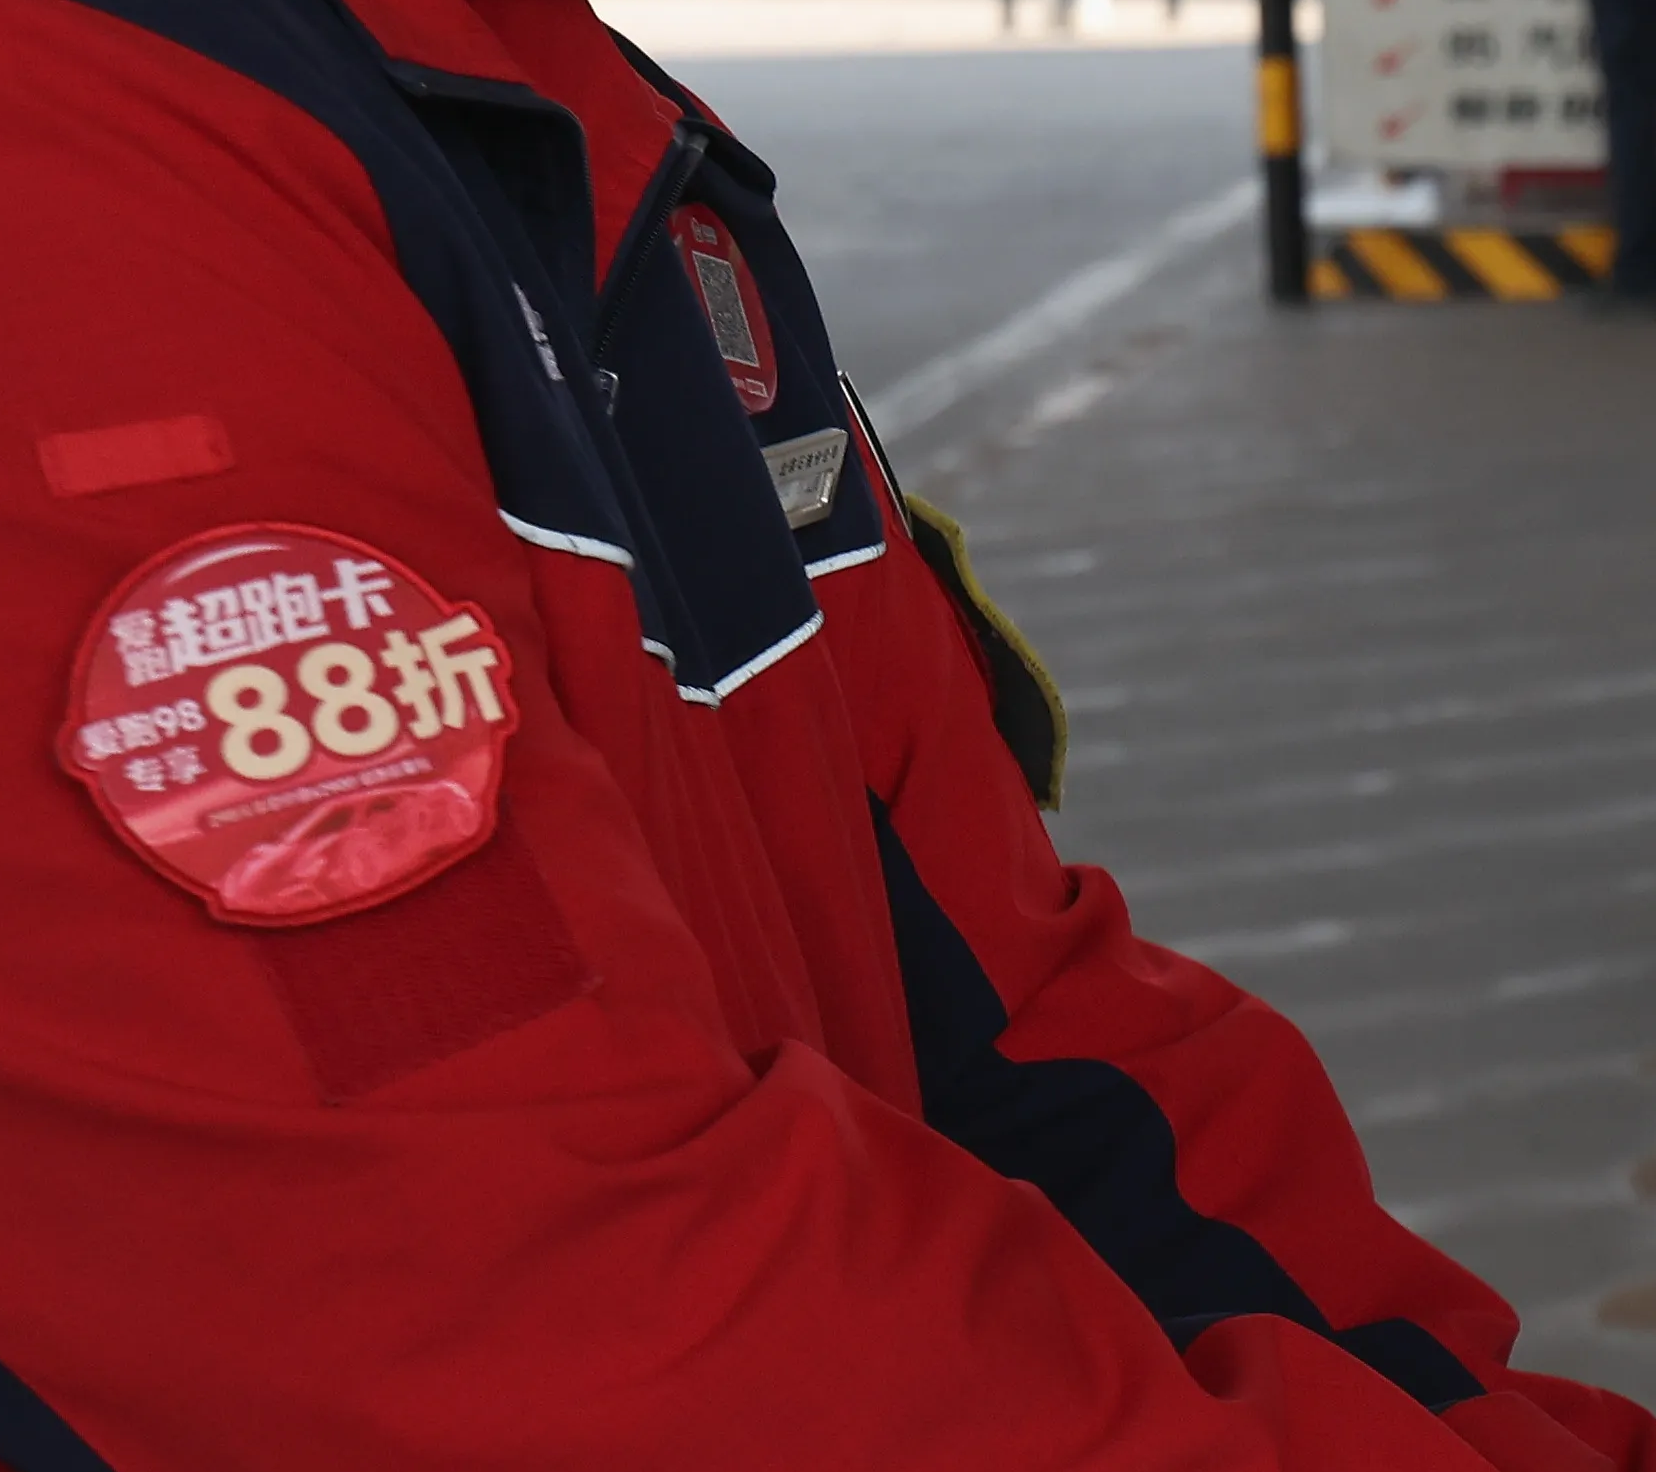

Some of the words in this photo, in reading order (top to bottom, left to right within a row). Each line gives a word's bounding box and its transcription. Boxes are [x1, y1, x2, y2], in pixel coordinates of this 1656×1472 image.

[160, 558, 395, 674] 超跑卡
[205, 612, 505, 781] 88折
